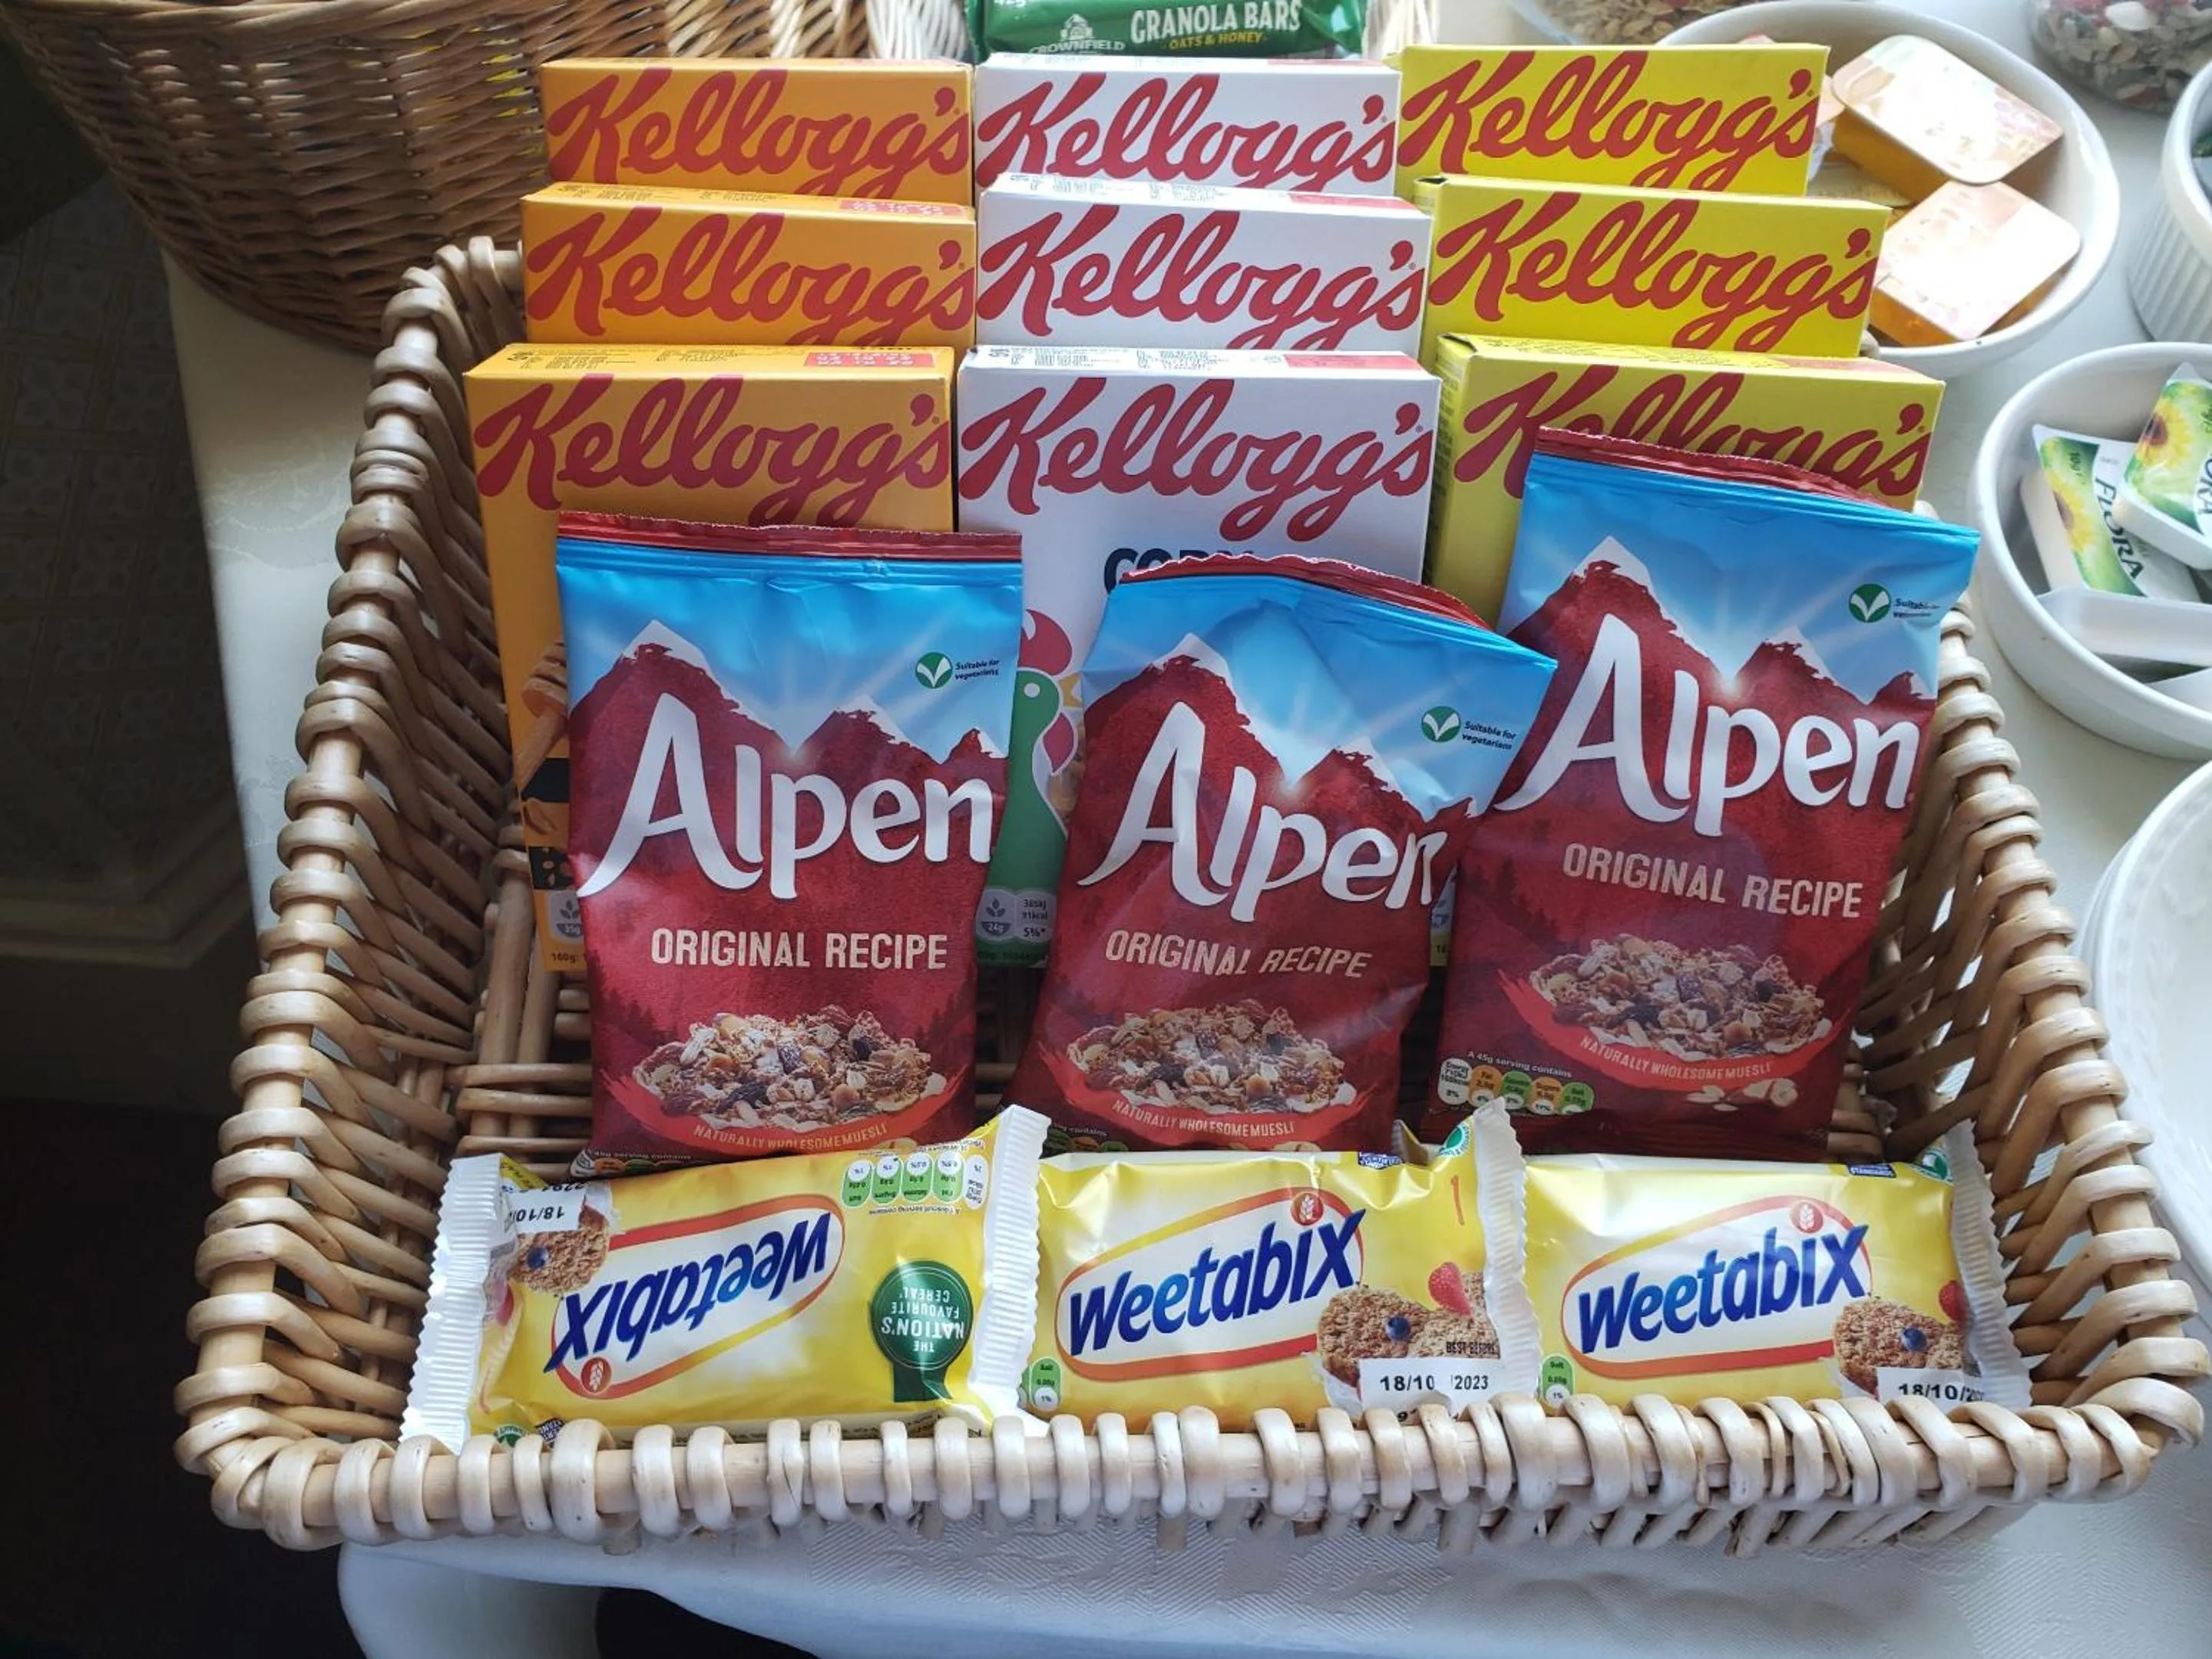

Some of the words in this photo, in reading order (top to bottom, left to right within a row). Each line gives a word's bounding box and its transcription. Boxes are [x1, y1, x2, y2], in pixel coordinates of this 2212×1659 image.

[1130, 2, 1238, 45] GRANOLA
[1243, 0, 1303, 32] BARS
[1168, 33, 1203, 51] OATS
[1205, 34, 1215, 45] &
[1218, 31, 1264, 46] HONEY
[548, 67, 969, 197] Kellogg's
[975, 72, 1397, 190] Kellogg's
[1398, 50, 1820, 191] Kellogg's
[526, 206, 977, 345] Kellogg's
[976, 203, 1425, 350] Kellogg's
[1428, 191, 1878, 352] Kellogg's
[473, 372, 950, 528] Kellogg's
[958, 376, 1433, 541] Kellogg's
[1462, 733, 1513, 750] vegetarians
[1464, 721, 1501, 737] Suitable
[1502, 729, 1516, 739] for
[1493, 613, 1920, 837] Alpen
[577, 691, 993, 900] Alpen
[1076, 700, 1448, 923] Alpen
[1562, 842, 1727, 905] ORIGINAL
[1741, 874, 1863, 919] RECIPE
[650, 927, 811, 969] ORIGINAL
[825, 932, 948, 970] RECIPE
[1105, 929, 1251, 976] ORIGINAL
[1258, 944, 1374, 979] RECIPE
[1496, 1057, 1530, 1072] serving
[1531, 1065, 1572, 1078] contains
[1580, 1035, 1650, 1073] NATURALLY
[1651, 1060, 1722, 1081] WHOLESOME
[1722, 1061, 1773, 1080] MUESLI
[694, 1123, 765, 1149] NATURALLY
[766, 1129, 842, 1151] WHOLESOME
[842, 1123, 888, 1147] MUESLI
[1111, 1099, 1178, 1128] NATURALLY
[1179, 1116, 1250, 1137] WHOLESOME
[1250, 1121, 1294, 1138] MUESLI
[542, 1211, 832, 1373] Weetabix
[881, 1316, 964, 1340] NATION'S
[890, 1301, 960, 1319] FAVOURITE
[1069, 1208, 1367, 1357] Weetabix
[1578, 1224, 1869, 1355] Weetabix
[912, 1340, 935, 1353] THE
